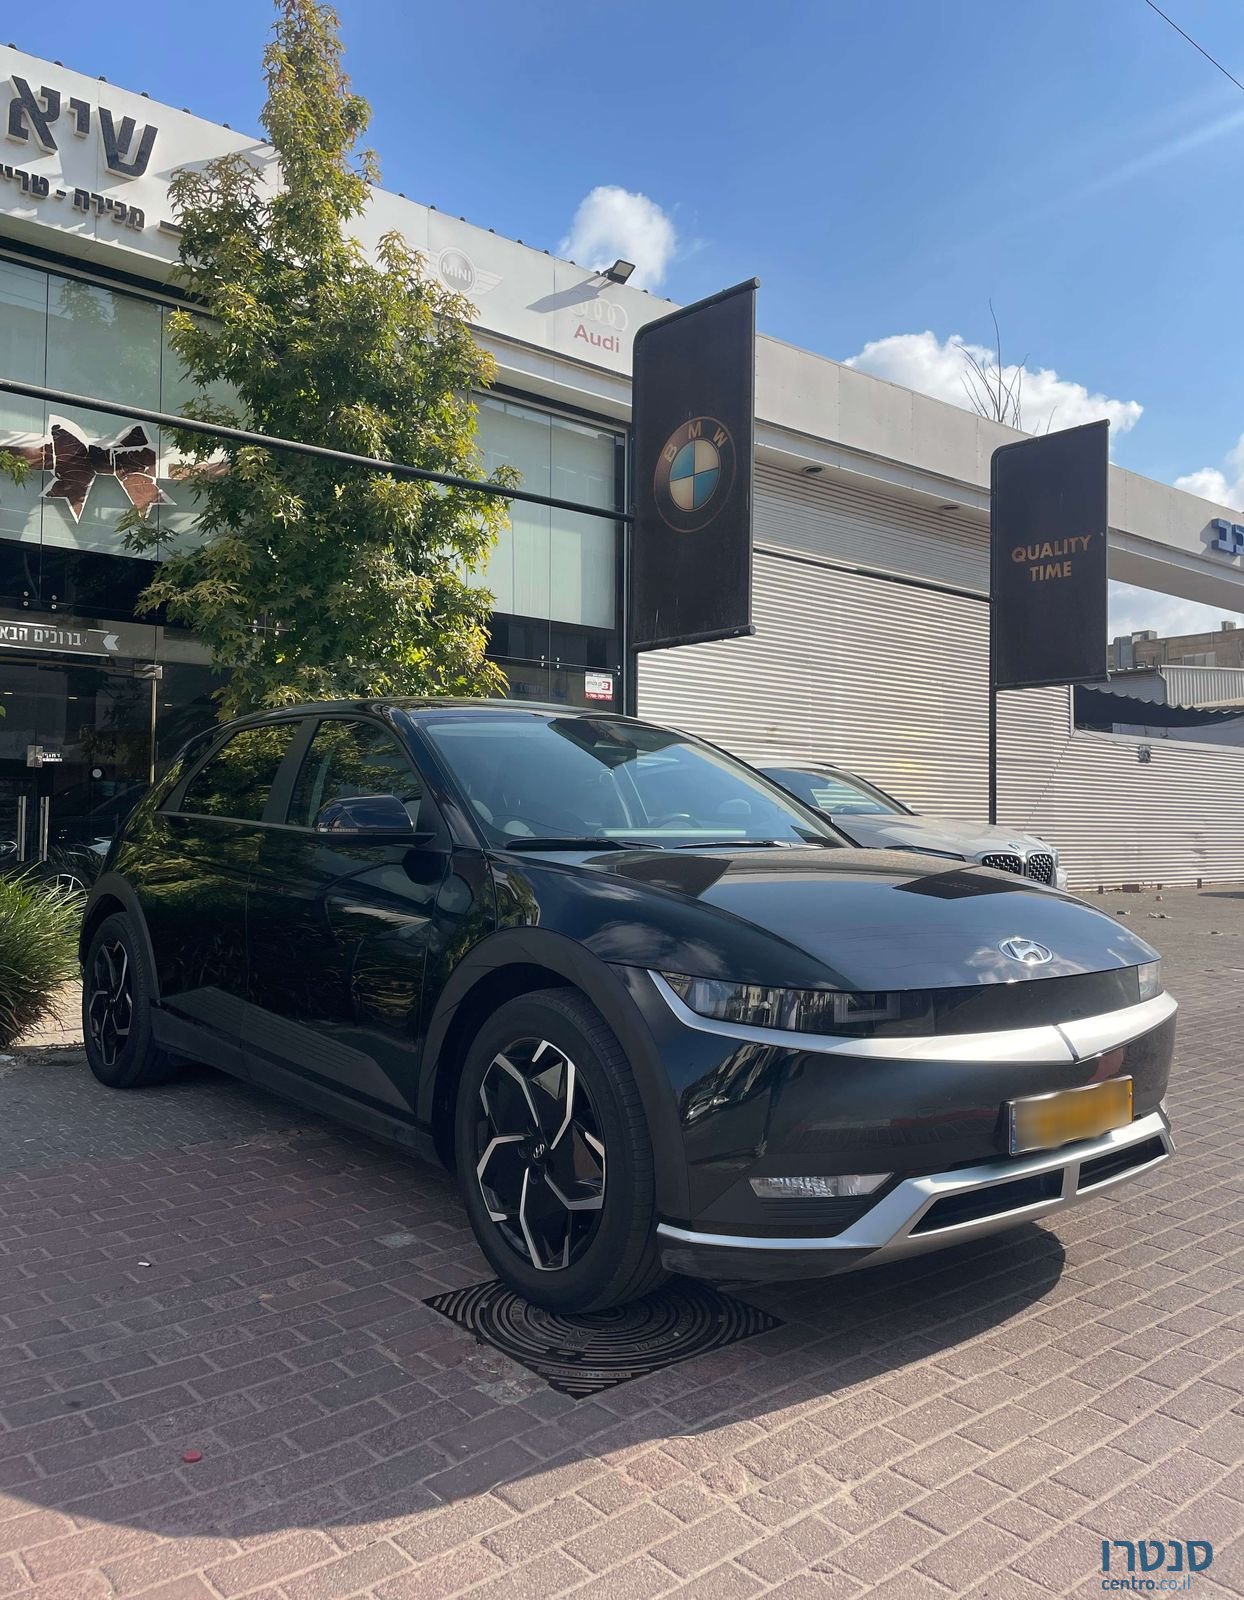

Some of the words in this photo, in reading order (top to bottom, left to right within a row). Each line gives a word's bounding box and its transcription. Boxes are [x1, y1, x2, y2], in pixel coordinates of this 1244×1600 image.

[8, 75, 158, 178] שיא
[73, 188, 145, 230] מכירה
[442, 261, 472, 282] MINI
[573, 324, 620, 353] Audi
[663, 420, 728, 462] BMW
[1011, 534, 1092, 563] QUALITY
[1030, 561, 1072, 582] TIME
[34, 628, 81, 646] ברוכים
